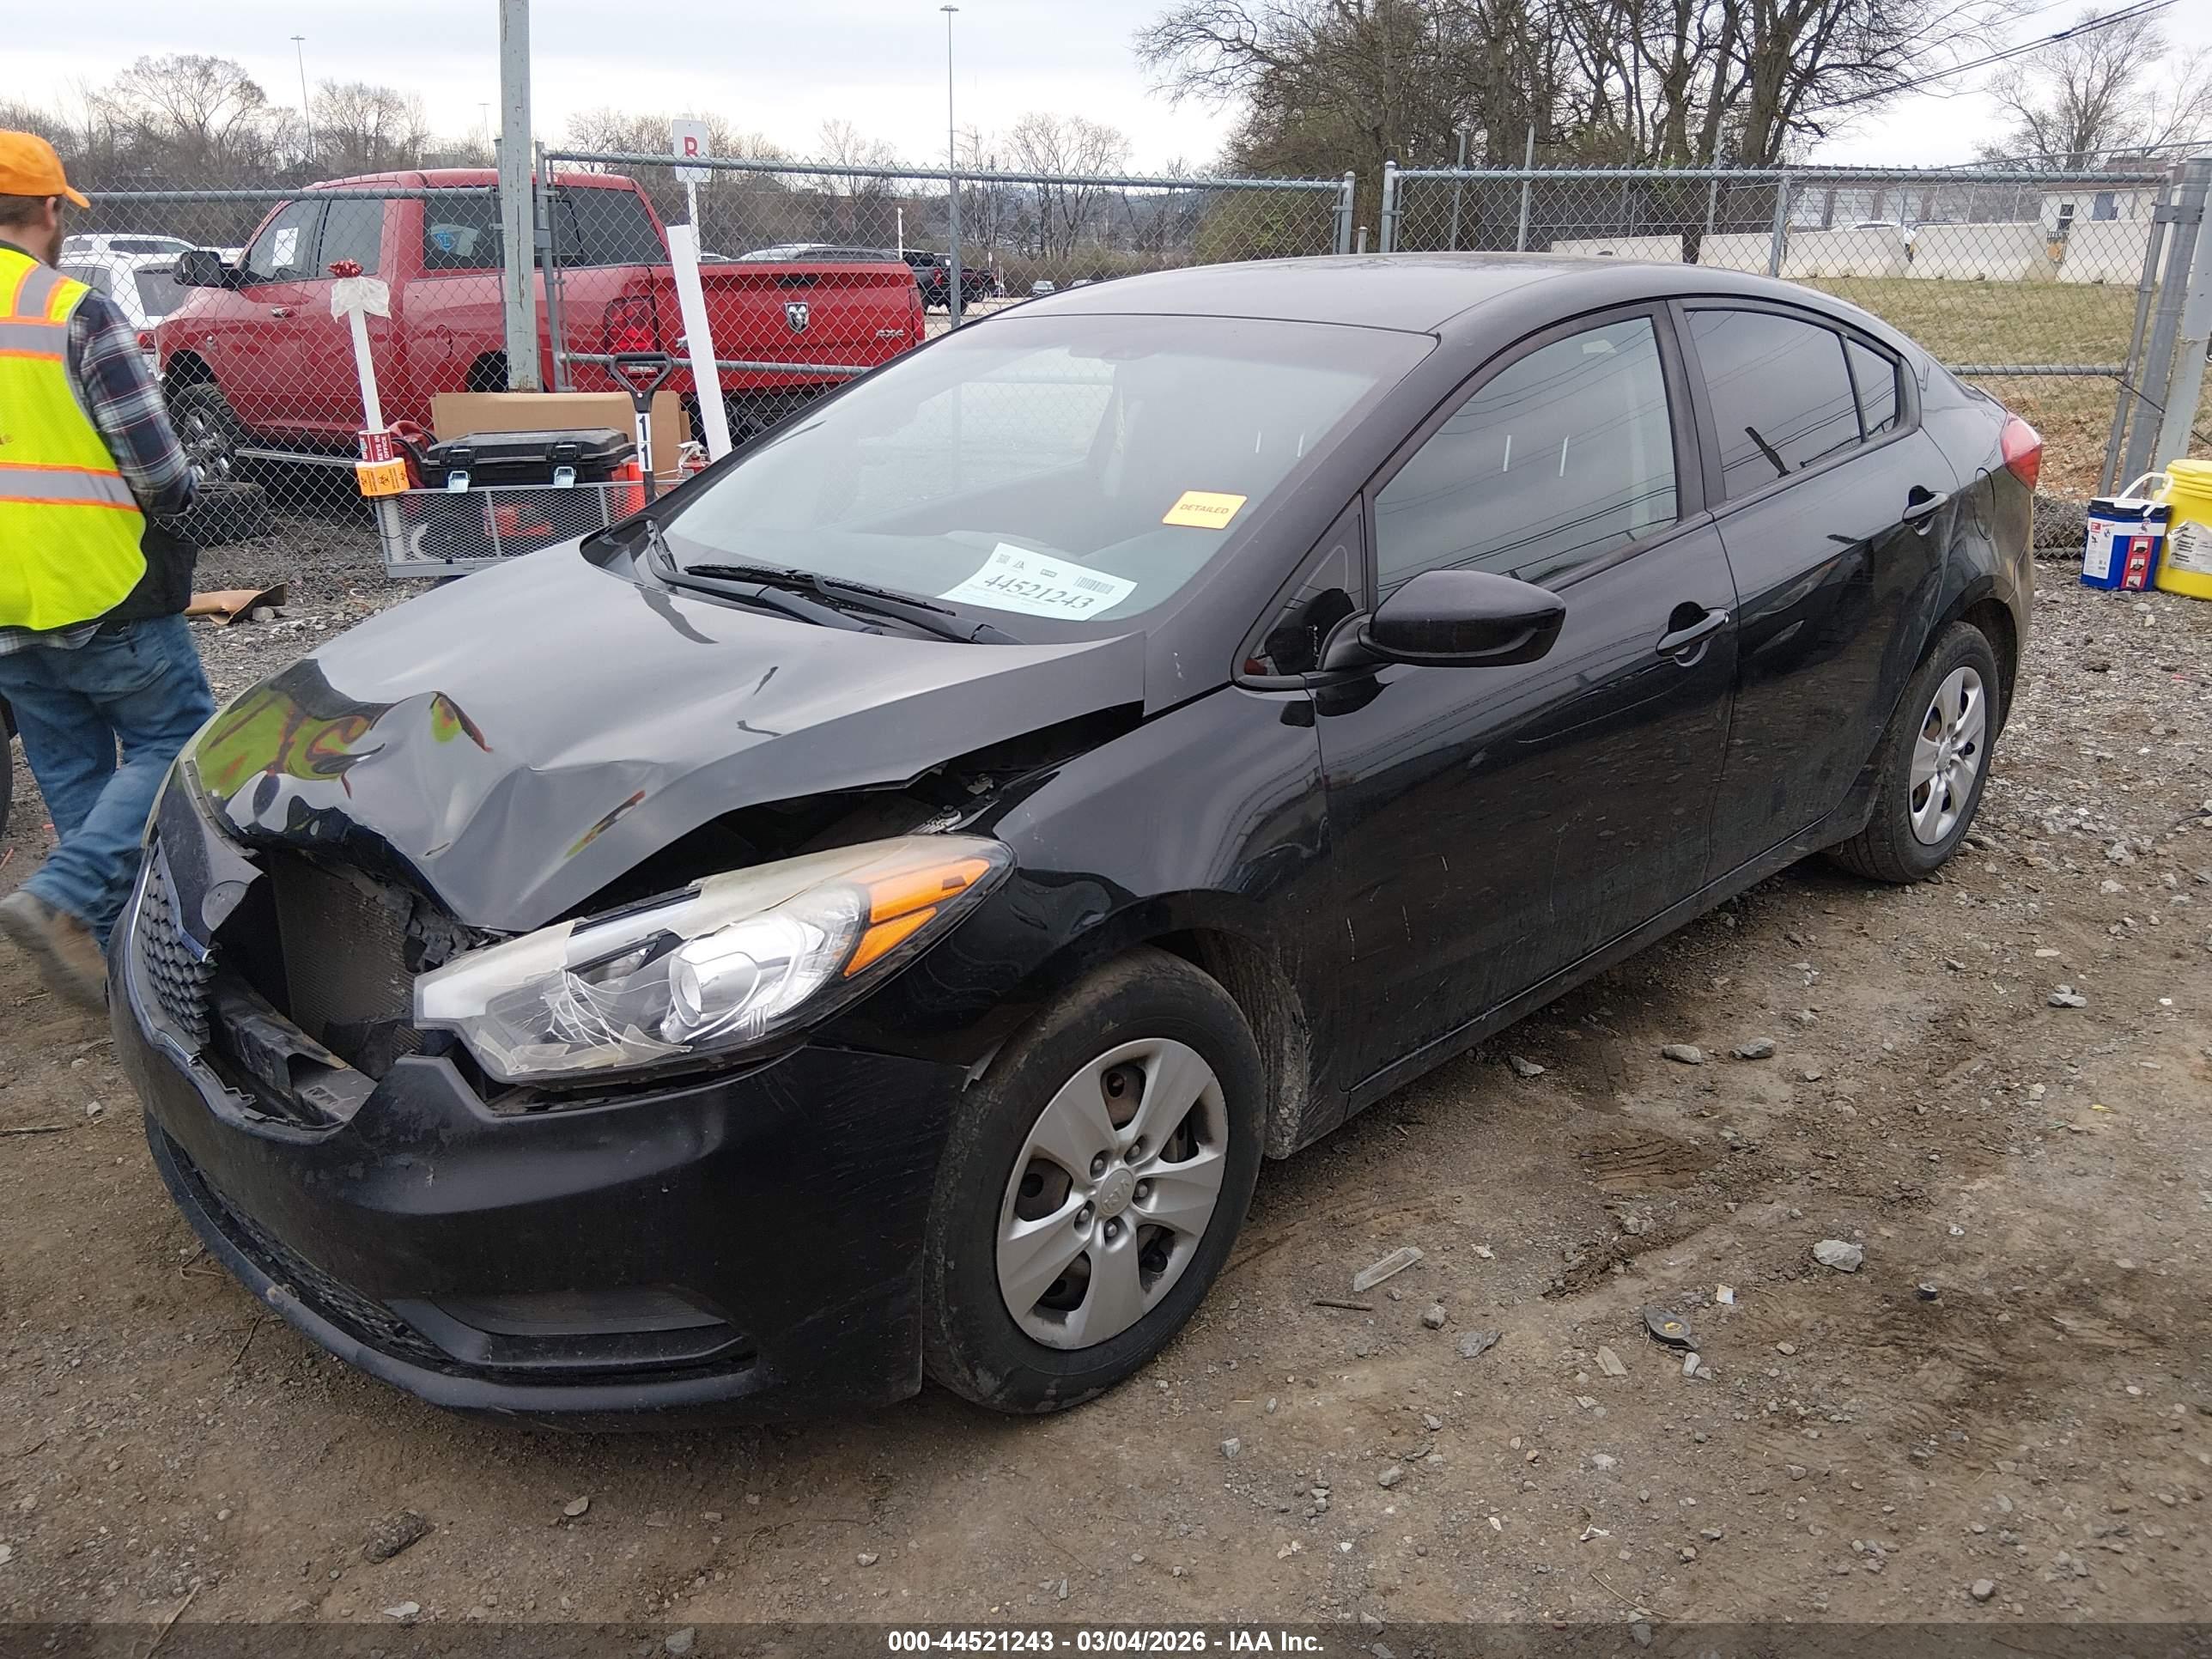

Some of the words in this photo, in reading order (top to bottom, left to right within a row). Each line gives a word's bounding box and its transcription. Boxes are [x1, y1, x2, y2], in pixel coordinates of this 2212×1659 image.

[684, 137, 698, 157] R
[374, 434, 380, 444] IN
[381, 436, 390, 459] OFFICE
[375, 444, 384, 461] KEYS
[1179, 503, 1230, 515] DETAILED
[983, 574, 1096, 610] 44521243
